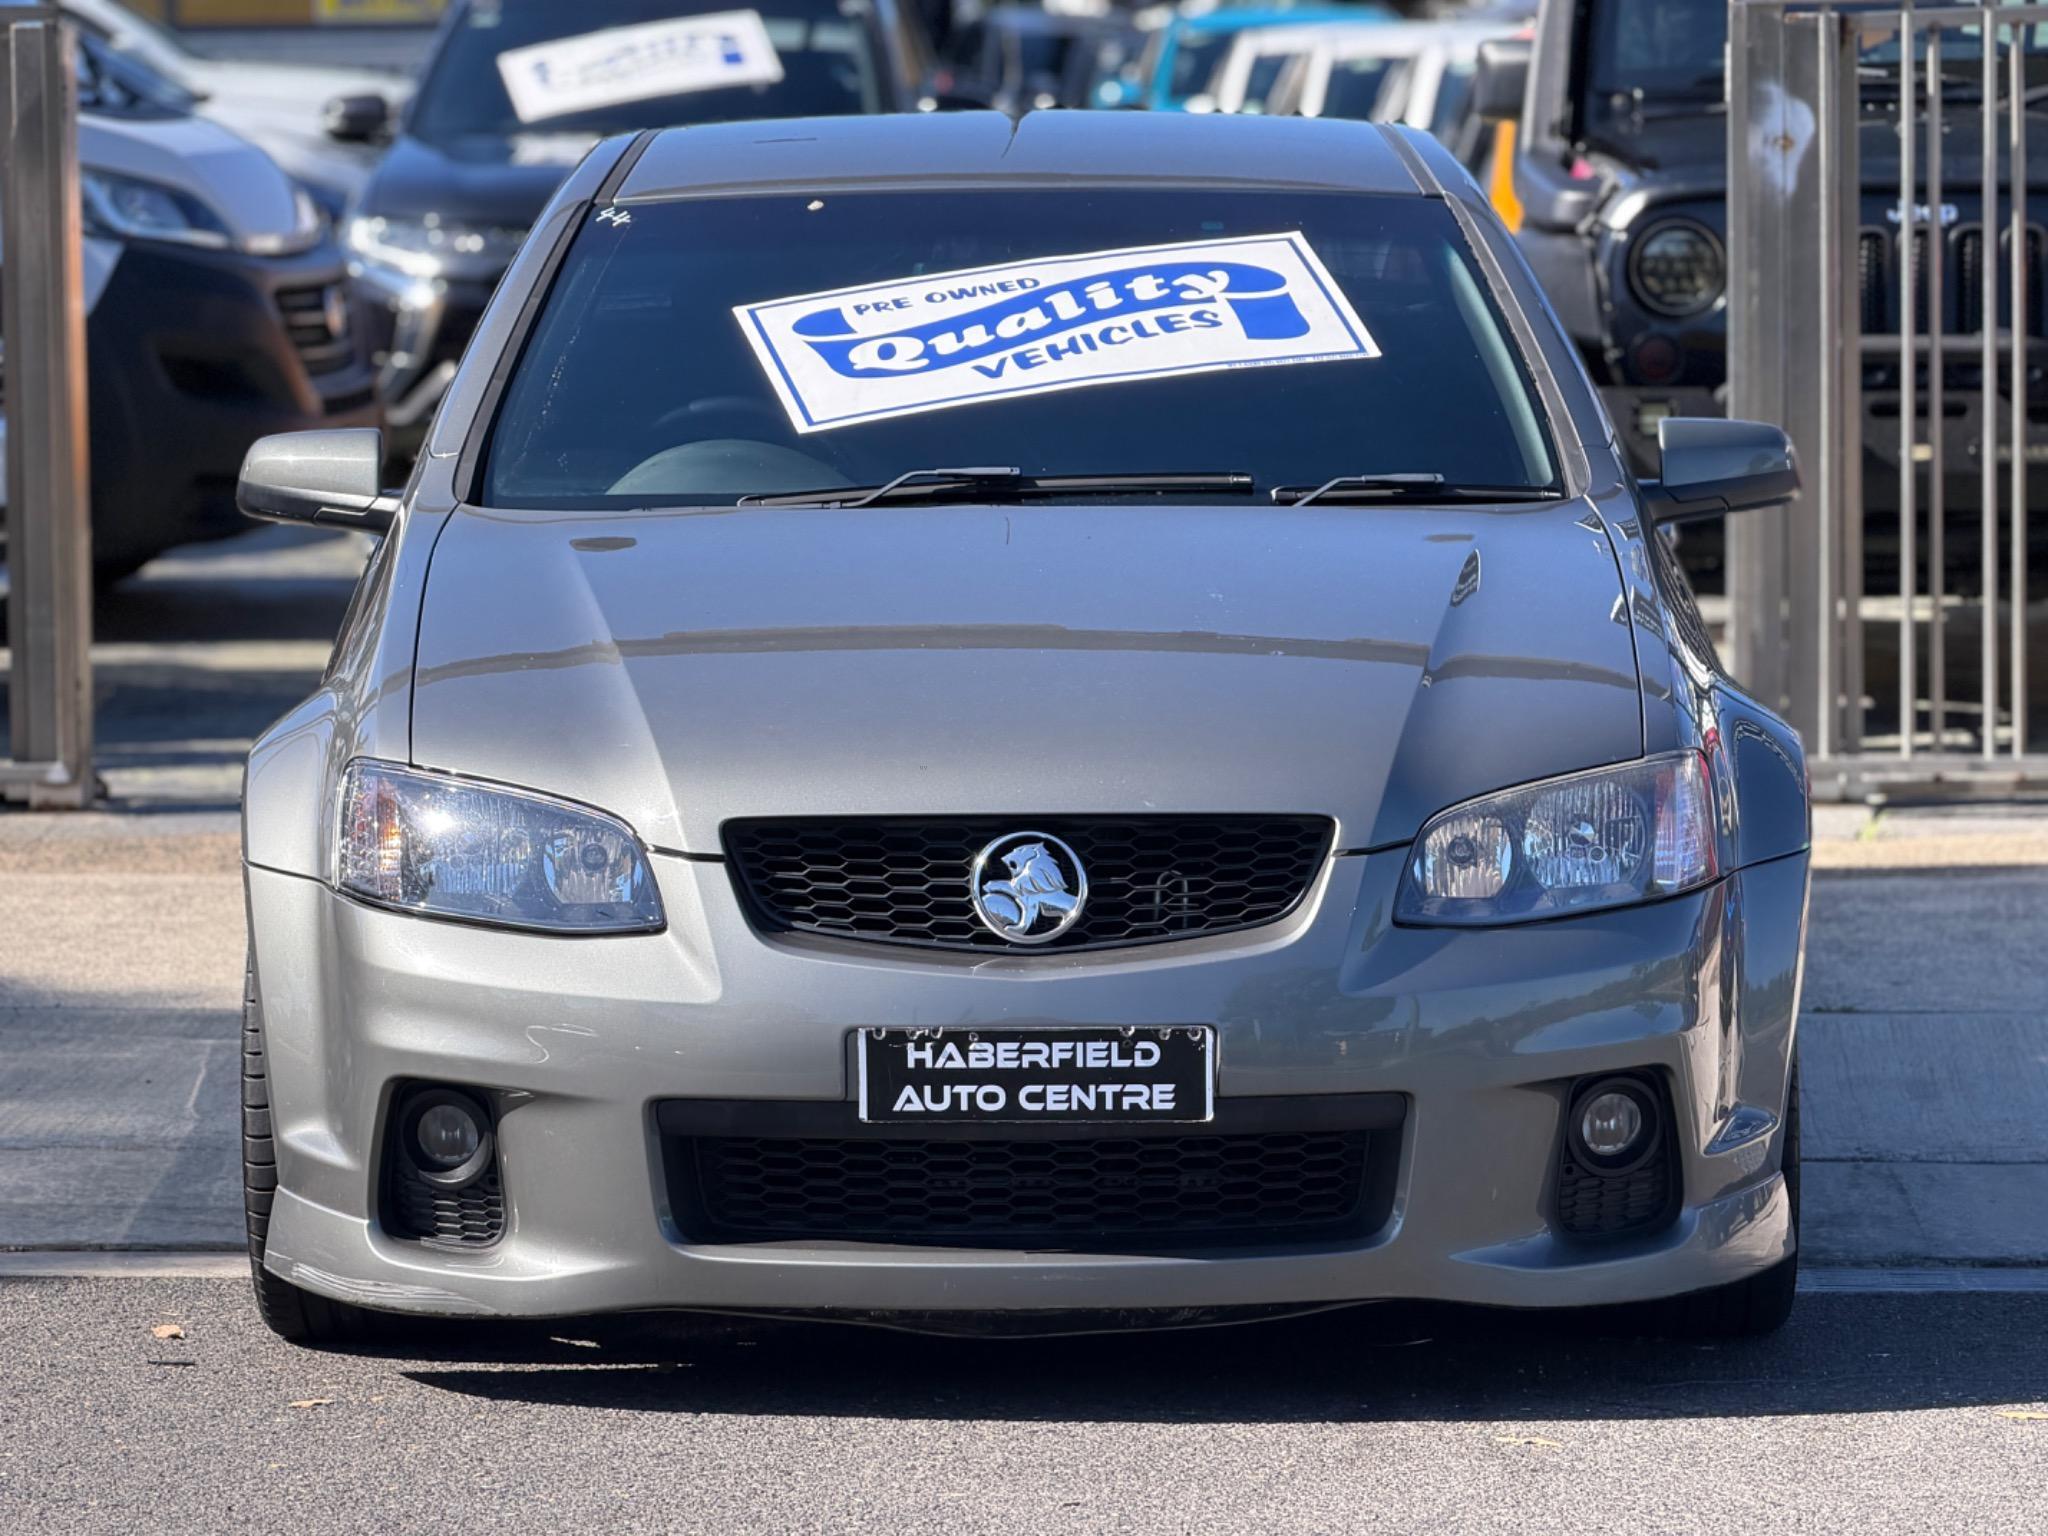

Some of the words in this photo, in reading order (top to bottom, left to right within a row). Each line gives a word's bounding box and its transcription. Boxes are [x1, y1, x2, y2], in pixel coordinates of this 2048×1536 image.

[853, 296, 913, 316] PRE
[925, 278, 1041, 303] OWNED
[849, 270, 1230, 371] Quality
[971, 310, 1223, 379] VEHICLES
[907, 1041, 1161, 1069] HABERFIELD
[893, 1085, 1006, 1111] AUTO
[1018, 1084, 1176, 1111] CENTRE
